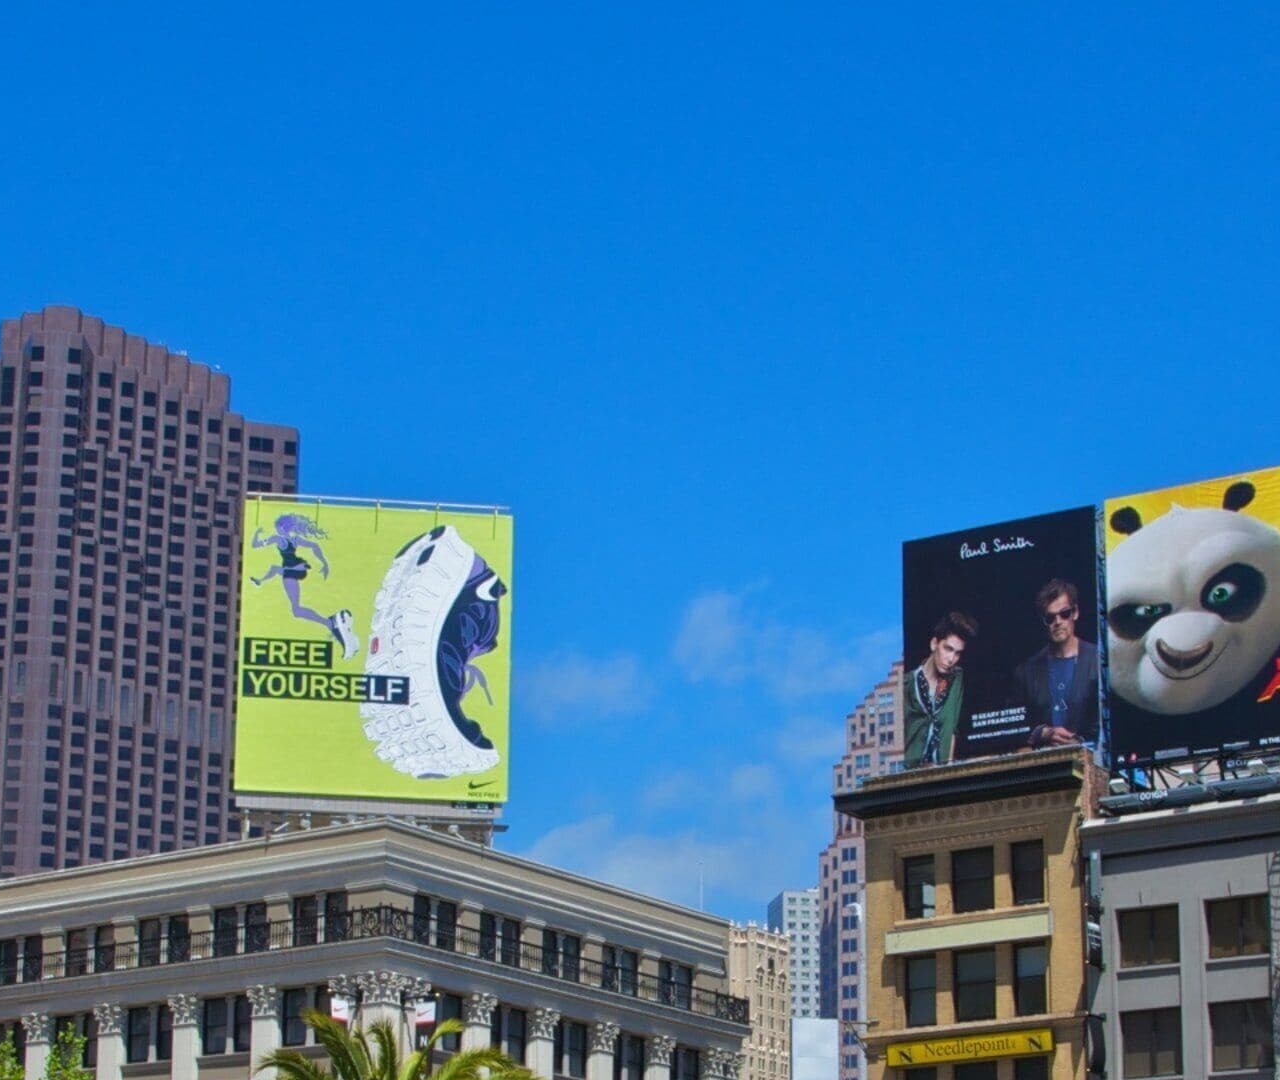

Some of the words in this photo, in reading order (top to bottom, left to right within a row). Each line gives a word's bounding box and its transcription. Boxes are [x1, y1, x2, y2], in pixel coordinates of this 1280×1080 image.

[960, 542, 989, 559] Paul
[993, 536, 1034, 552] Smith
[250, 640, 328, 666] FREE
[248, 672, 404, 702] YOURSELF
[899, 1048, 913, 1063] N
[923, 1038, 1009, 1058] Needlepoint
[1027, 1035, 1044, 1050] N
